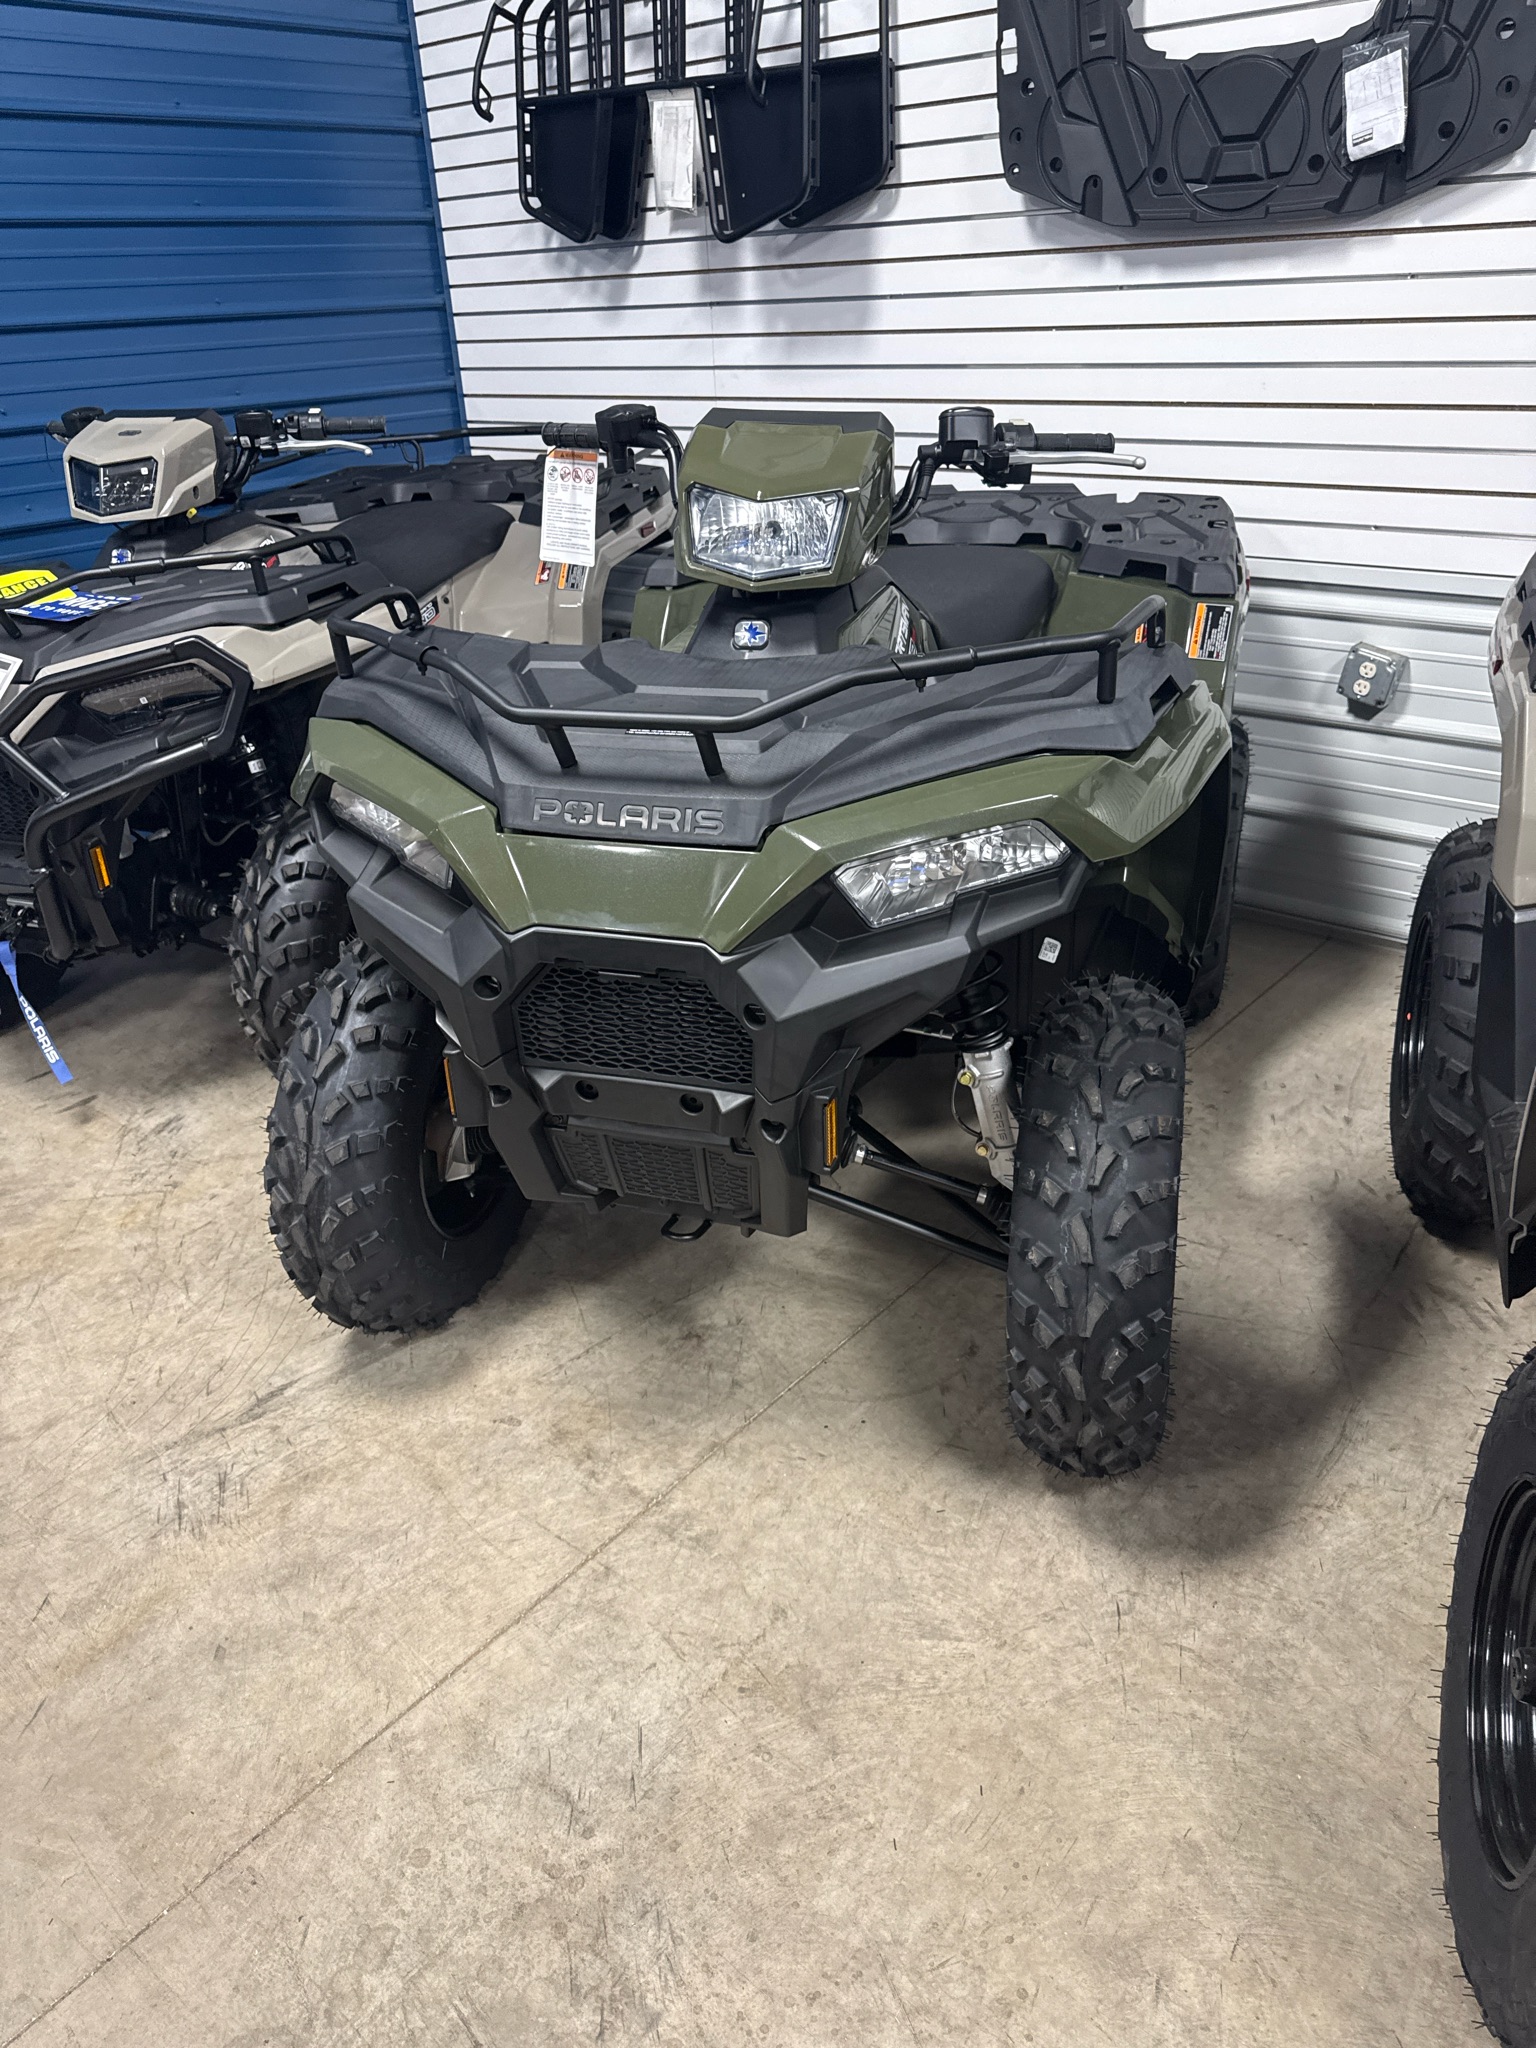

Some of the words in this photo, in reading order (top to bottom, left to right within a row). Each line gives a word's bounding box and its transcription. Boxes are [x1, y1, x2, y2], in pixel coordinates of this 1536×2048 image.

[0, 576, 49, 599] ANCE
[57, 596, 120, 611] RICE
[532, 797, 725, 836] POLARIS
[19, 995, 60, 1064] POLARIS
